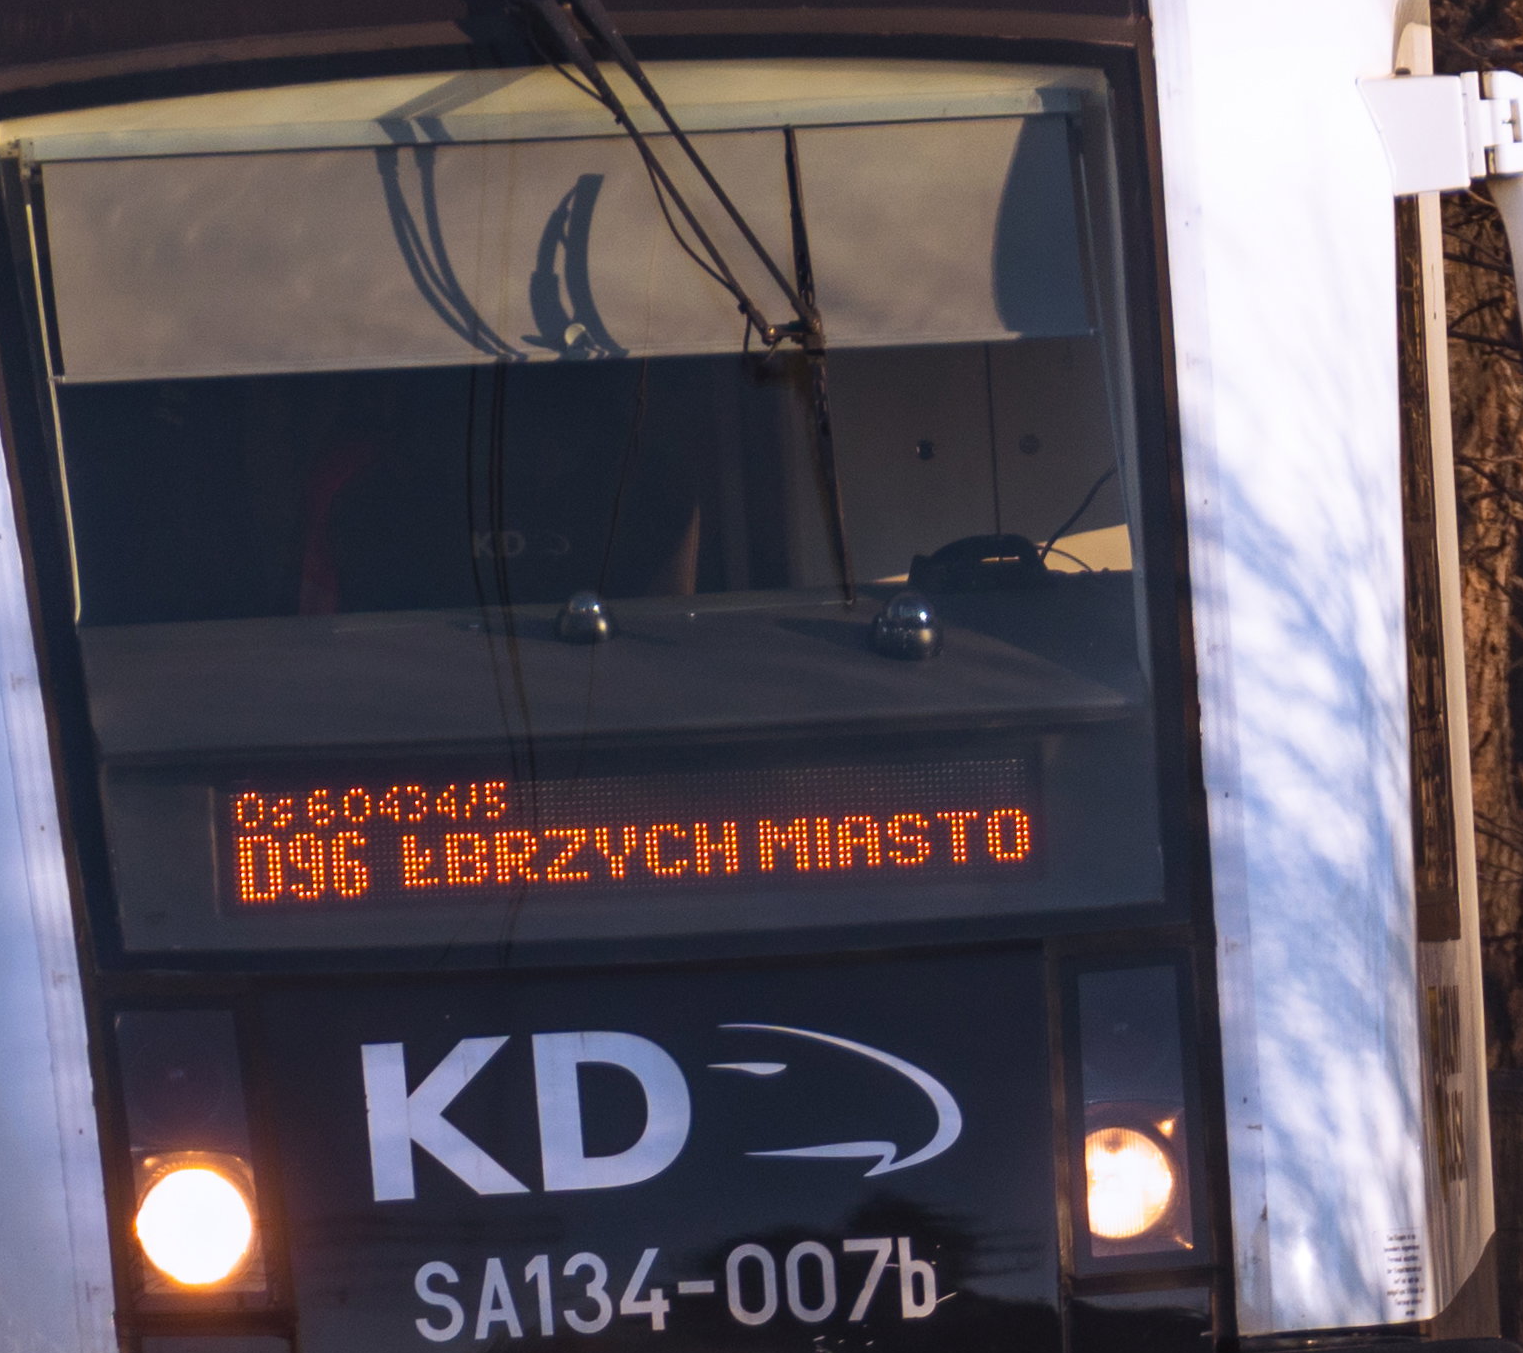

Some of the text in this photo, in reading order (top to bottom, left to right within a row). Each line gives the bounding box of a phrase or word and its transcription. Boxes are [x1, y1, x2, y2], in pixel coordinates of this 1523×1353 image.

[236, 780, 508, 828] Os 60434/5
[237, 807, 1031, 902] D96 ŁBRZYCH MIASTO
[361, 1031, 692, 1202] KD
[413, 1235, 939, 1343] SA134-007b
